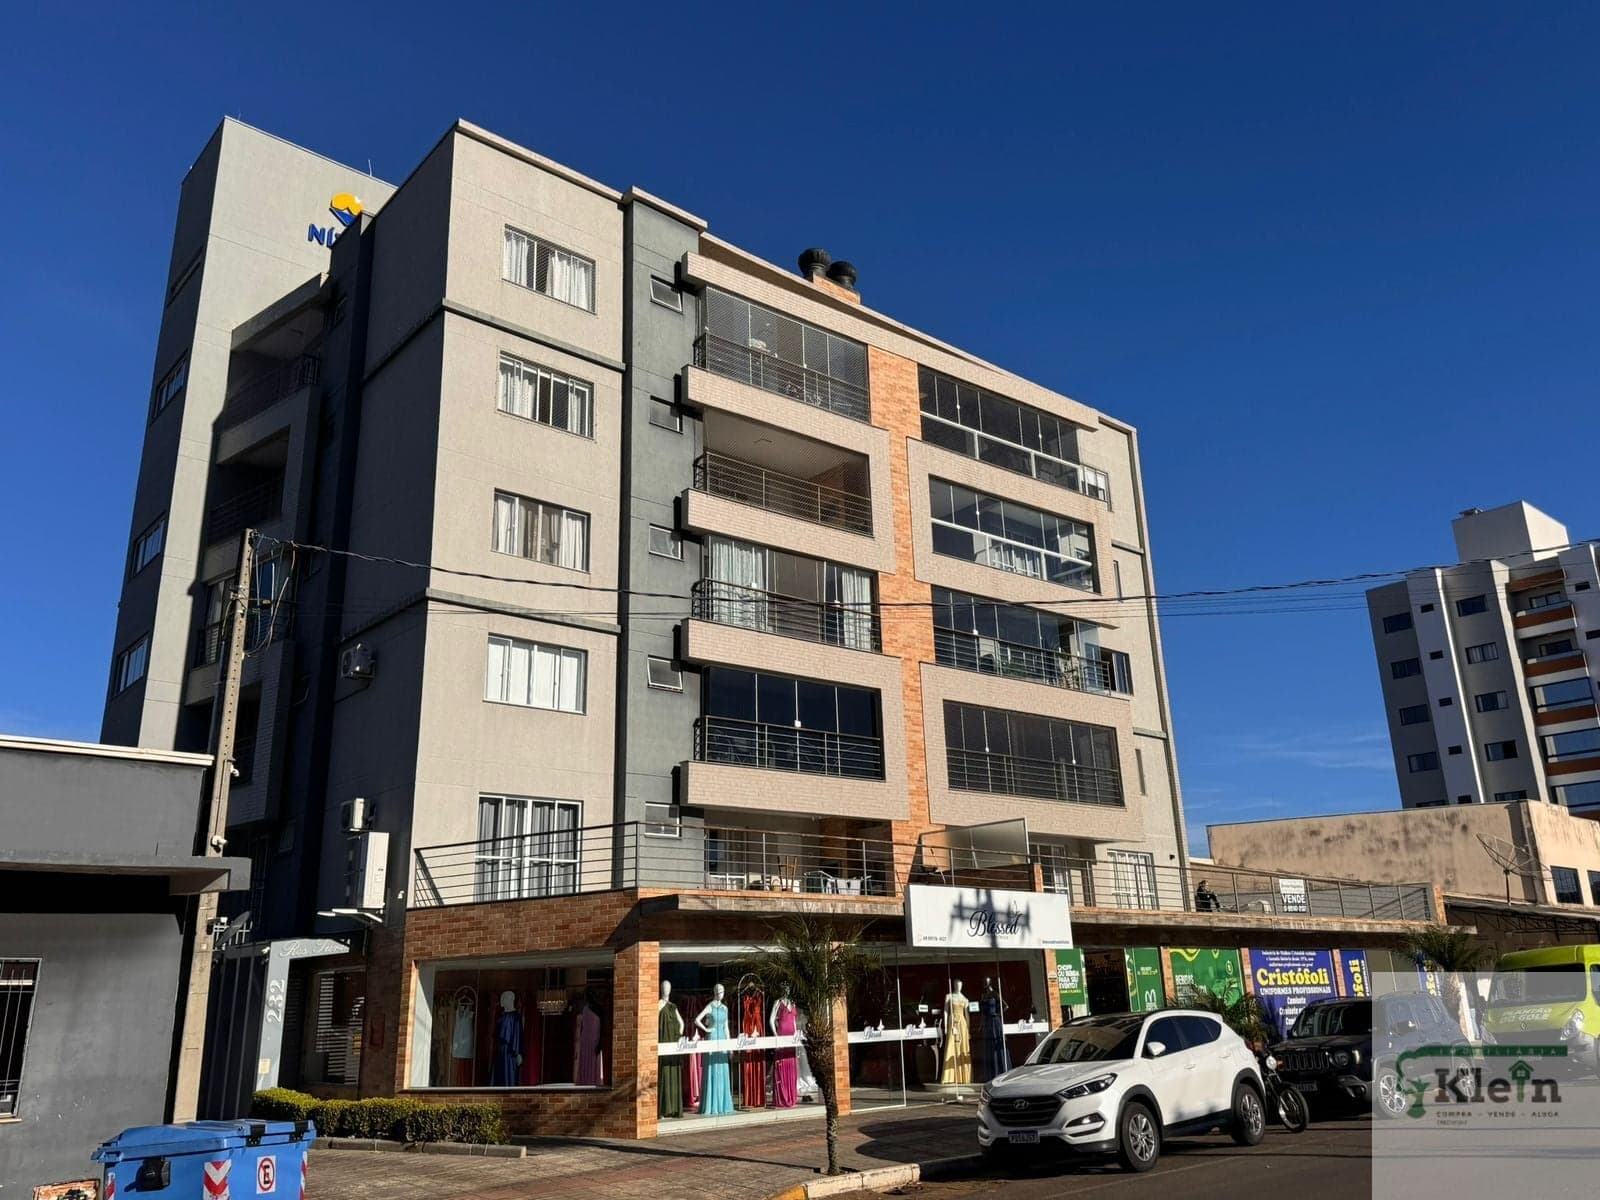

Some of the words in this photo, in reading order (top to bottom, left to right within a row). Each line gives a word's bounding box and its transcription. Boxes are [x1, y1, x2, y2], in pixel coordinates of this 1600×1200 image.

[1282, 894, 1306, 904] VENDE
[967, 910, 1025, 937] Blessed
[1256, 968, 1330, 986] Cristófoli
[266, 979, 285, 1023] 232
[263, 1164, 271, 1185] E
